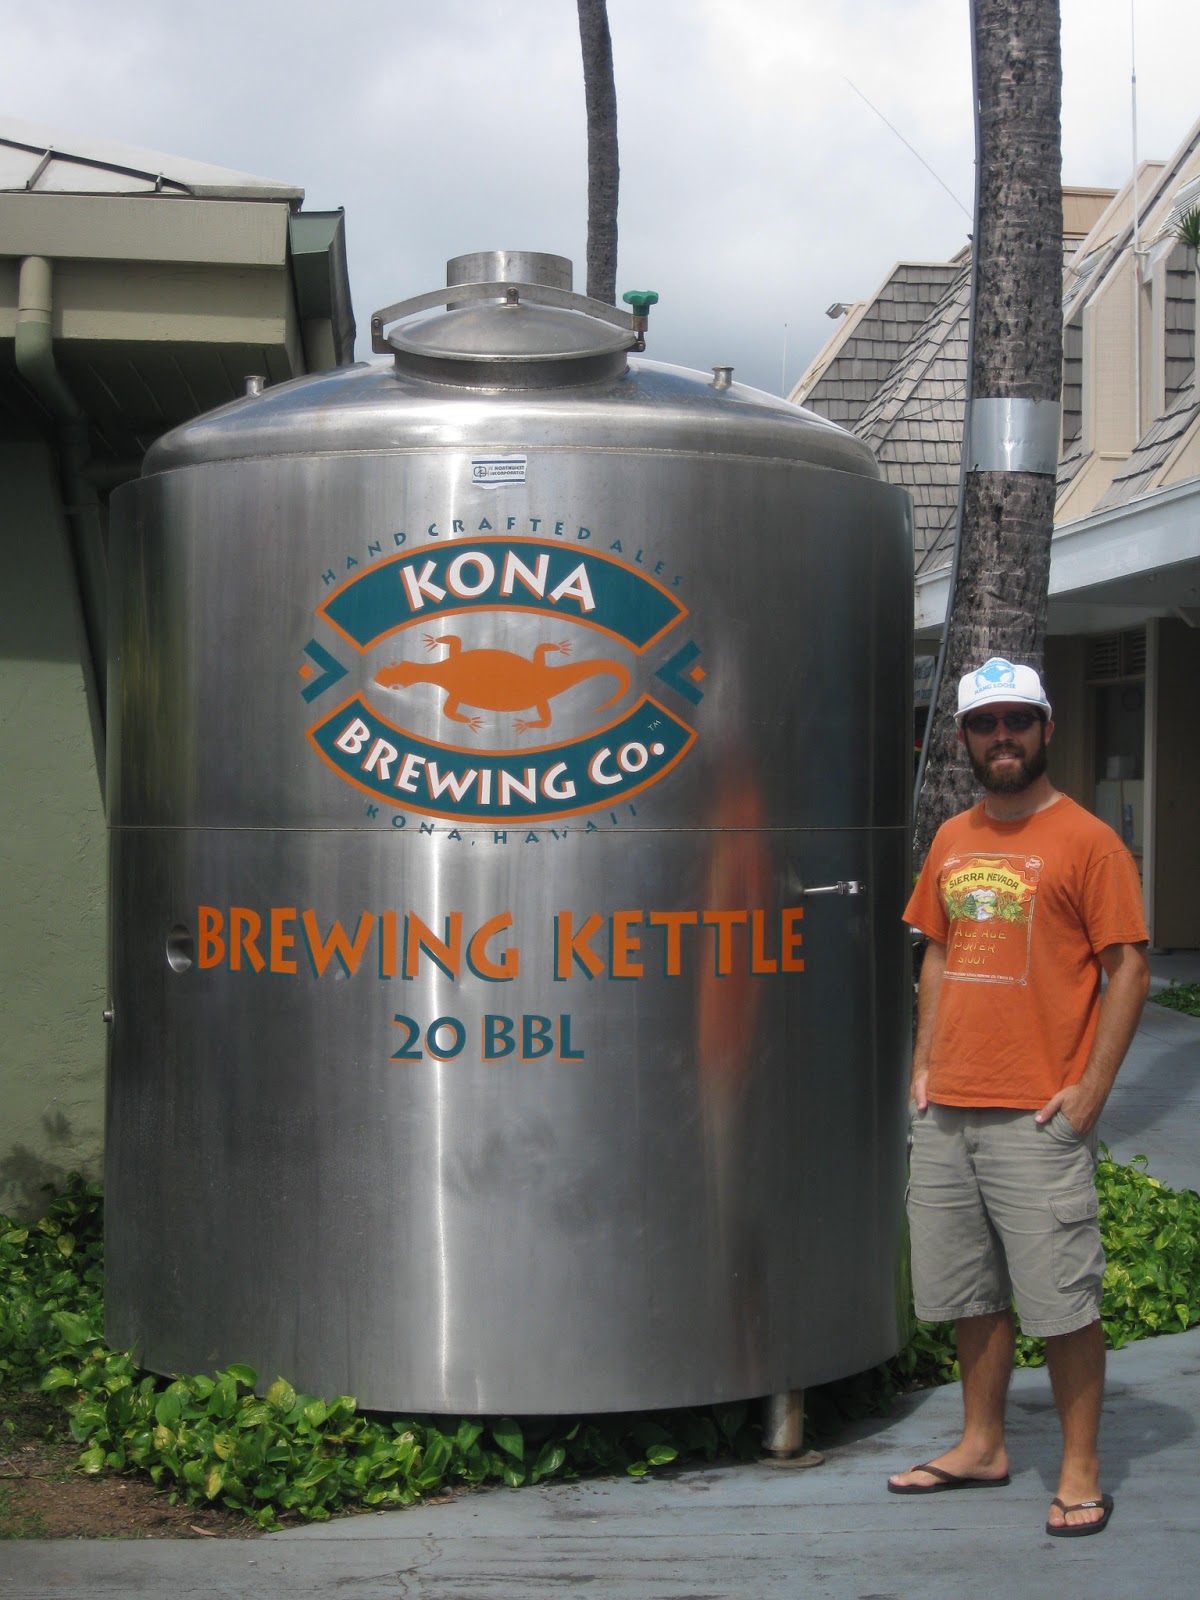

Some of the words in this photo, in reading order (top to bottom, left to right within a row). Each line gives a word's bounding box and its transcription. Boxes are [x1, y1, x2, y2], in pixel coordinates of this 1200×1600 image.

[427, 517, 591, 540] CRAFTED
[609, 539, 682, 588] ALES
[400, 550, 596, 613] KONA
[974, 683, 992, 695] HANG
[334, 717, 577, 806] BREWING
[366, 804, 475, 846] KONA,
[493, 804, 637, 845] HAWAII
[949, 872, 984, 889] SIERRA
[986, 872, 1020, 890] NEVADA
[195, 905, 519, 982] BREWING
[553, 907, 805, 982] KETTLE
[388, 1013, 466, 1063] 20
[481, 1014, 585, 1064] BBL
